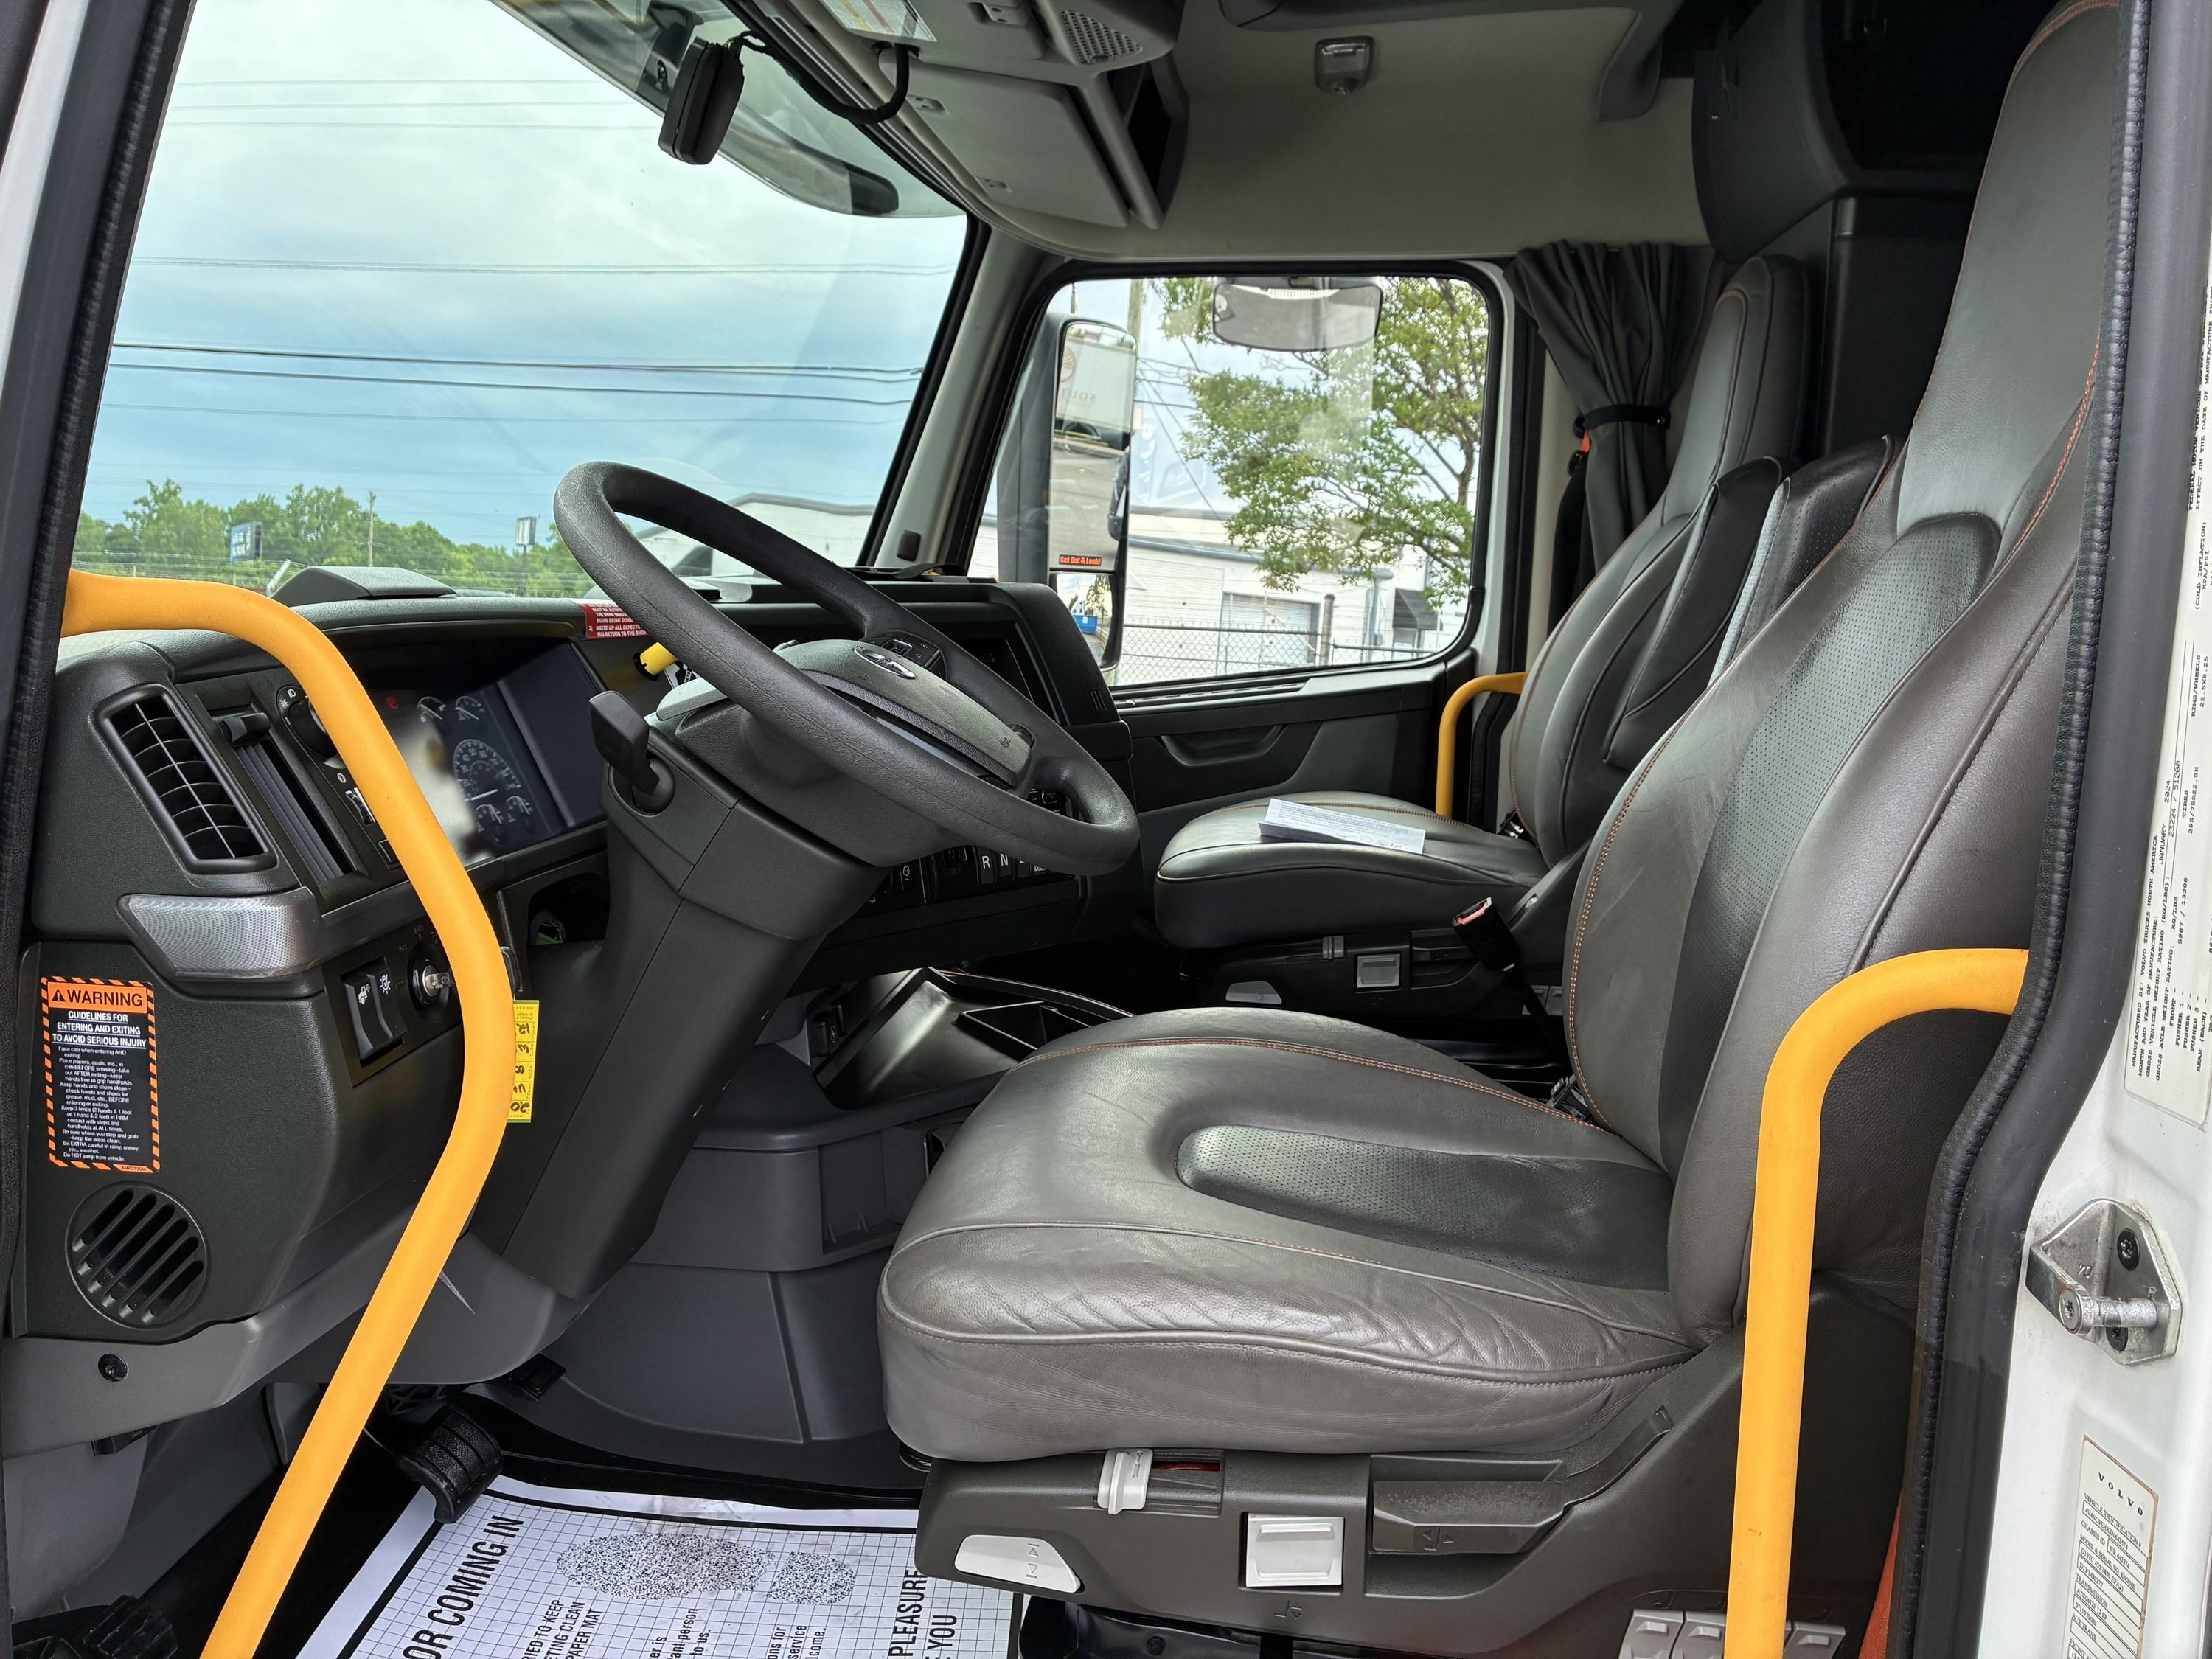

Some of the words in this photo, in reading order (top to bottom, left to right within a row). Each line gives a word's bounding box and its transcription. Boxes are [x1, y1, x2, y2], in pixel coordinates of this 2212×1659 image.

[2199, 459, 2203, 470] ON
[2203, 390, 2208, 401] OF
[2197, 522, 2206, 577] INFLATION)
[2191, 655, 2200, 717] RIMS/WHEELS
[2158, 823, 2166, 864] JANUARY
[982, 856, 990, 869] R
[1001, 854, 1009, 866] N
[2148, 916, 2158, 979] MANUFACTURE:
[2166, 945, 2174, 983] RATING:
[67, 990, 142, 1006] WARNING
[2147, 984, 2151, 995] OF
[57, 1021, 93, 1032] ENTERING
[94, 1024, 110, 1032] AND
[111, 1025, 140, 1034] EXITING
[68, 1010, 111, 1020] GUIDELINES
[113, 1013, 128, 1022] FOR
[52, 1033, 62, 1041] TO
[63, 1034, 85, 1043] AVOID
[87, 1035, 118, 1045] SERIOUS
[119, 1037, 146, 1047] INJURY
[2131, 1002, 2142, 1067] MANUFACTURED
[2190, 1018, 2198, 1051] PUSHER
[2098, 1472, 2143, 1516] VOLVO
[2081, 1519, 2099, 1541] CHASSIS
[2100, 1536, 2105, 1546] ID
[2084, 1492, 2102, 1514] VEHICLE
[2103, 1509, 2138, 1545] IDENTIFICATION
[428, 1541, 509, 1626] COMING
[483, 1515, 524, 1537] IN
[2079, 1533, 2093, 1551] MODEL
[2098, 1550, 2112, 1568] SERIAL
[2120, 1571, 2135, 1590] ENGINE
[2076, 1573, 2107, 1608] TRANSMISSION
[542, 1600, 564, 1623] KEEP
[560, 1601, 585, 1632] CLEAN
[582, 1608, 602, 1628] MAT
[678, 1608, 699, 1640] person
[534, 1625, 552, 1637] TO
[689, 1647, 704, 1655] to
[697, 1630, 711, 1643] us.
[771, 1627, 786, 1640] for
[788, 1626, 807, 1659] service
[927, 1615, 957, 1650] YOU
